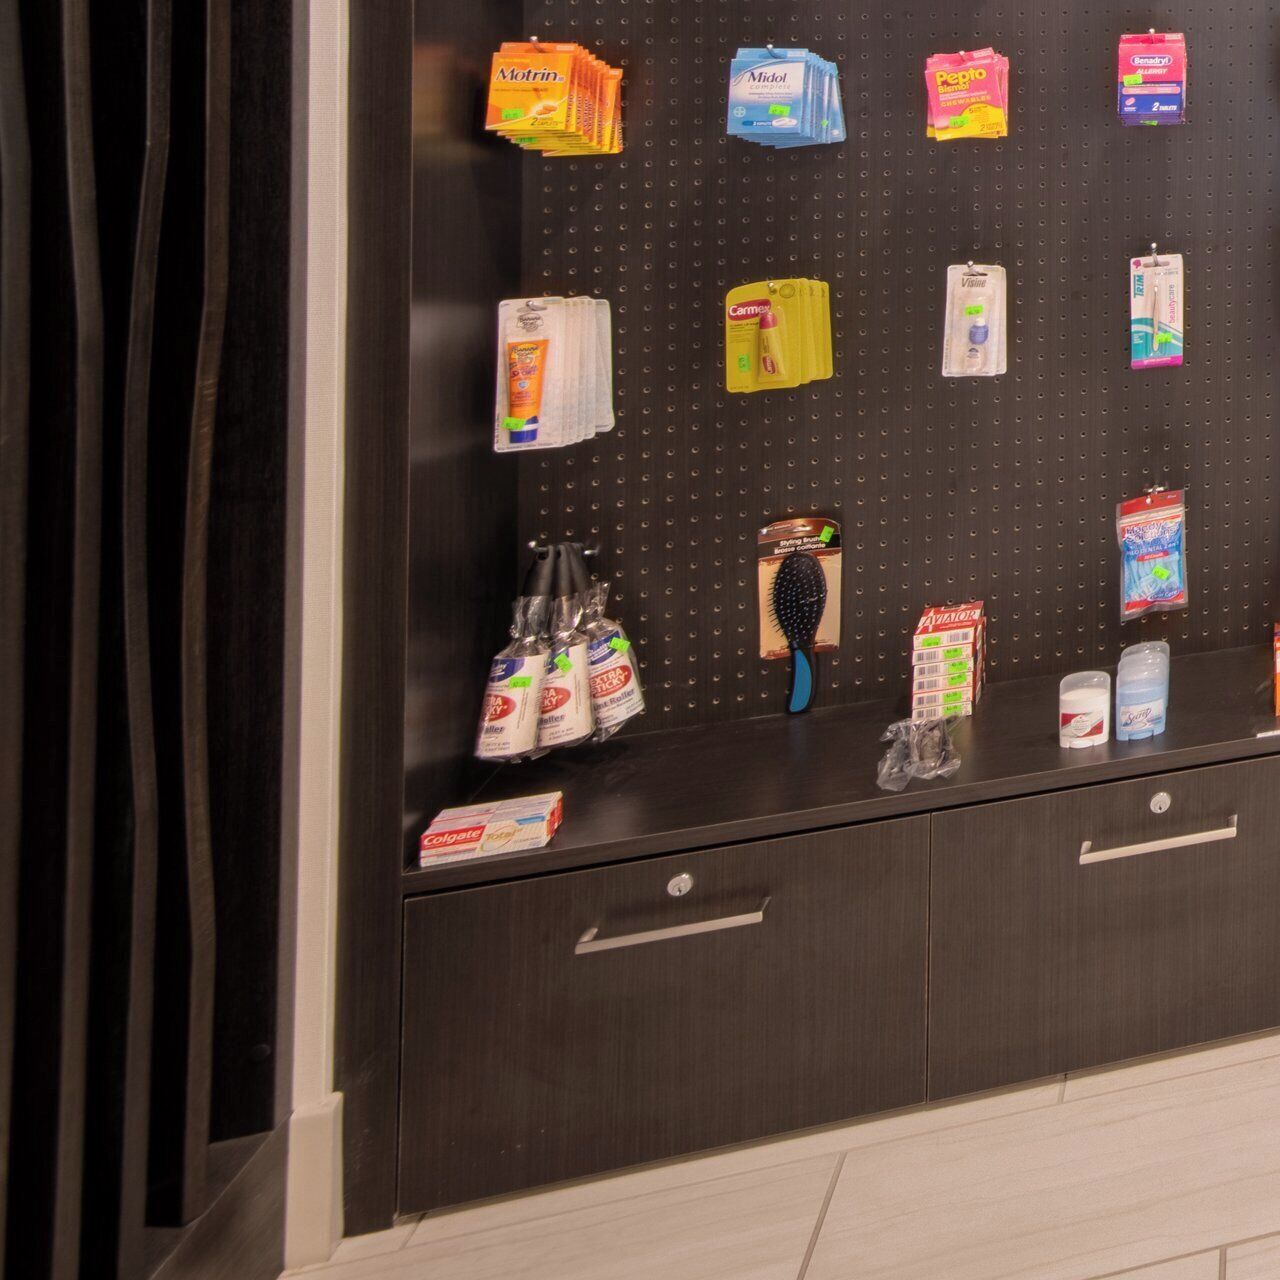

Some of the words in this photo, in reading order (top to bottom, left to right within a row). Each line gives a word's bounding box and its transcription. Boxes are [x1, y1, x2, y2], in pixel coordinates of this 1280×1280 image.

[1133, 56, 1170, 66] Benadryl
[496, 66, 557, 82] Motrin
[747, 71, 787, 85] Midol
[936, 68, 987, 86] Pepto
[938, 81, 970, 94] Bismol
[940, 95, 992, 107] CHEWABLES
[1152, 102, 1159, 111] 2
[961, 277, 987, 288] Visine
[1133, 273, 1145, 299] TRIM
[728, 304, 770, 316] Carmex
[1168, 283, 1176, 324] beautycare
[780, 537, 801, 548] Styling
[590, 667, 626, 685] EXTRA
[608, 688, 635, 705] Roller
[424, 828, 484, 847] Colgate
